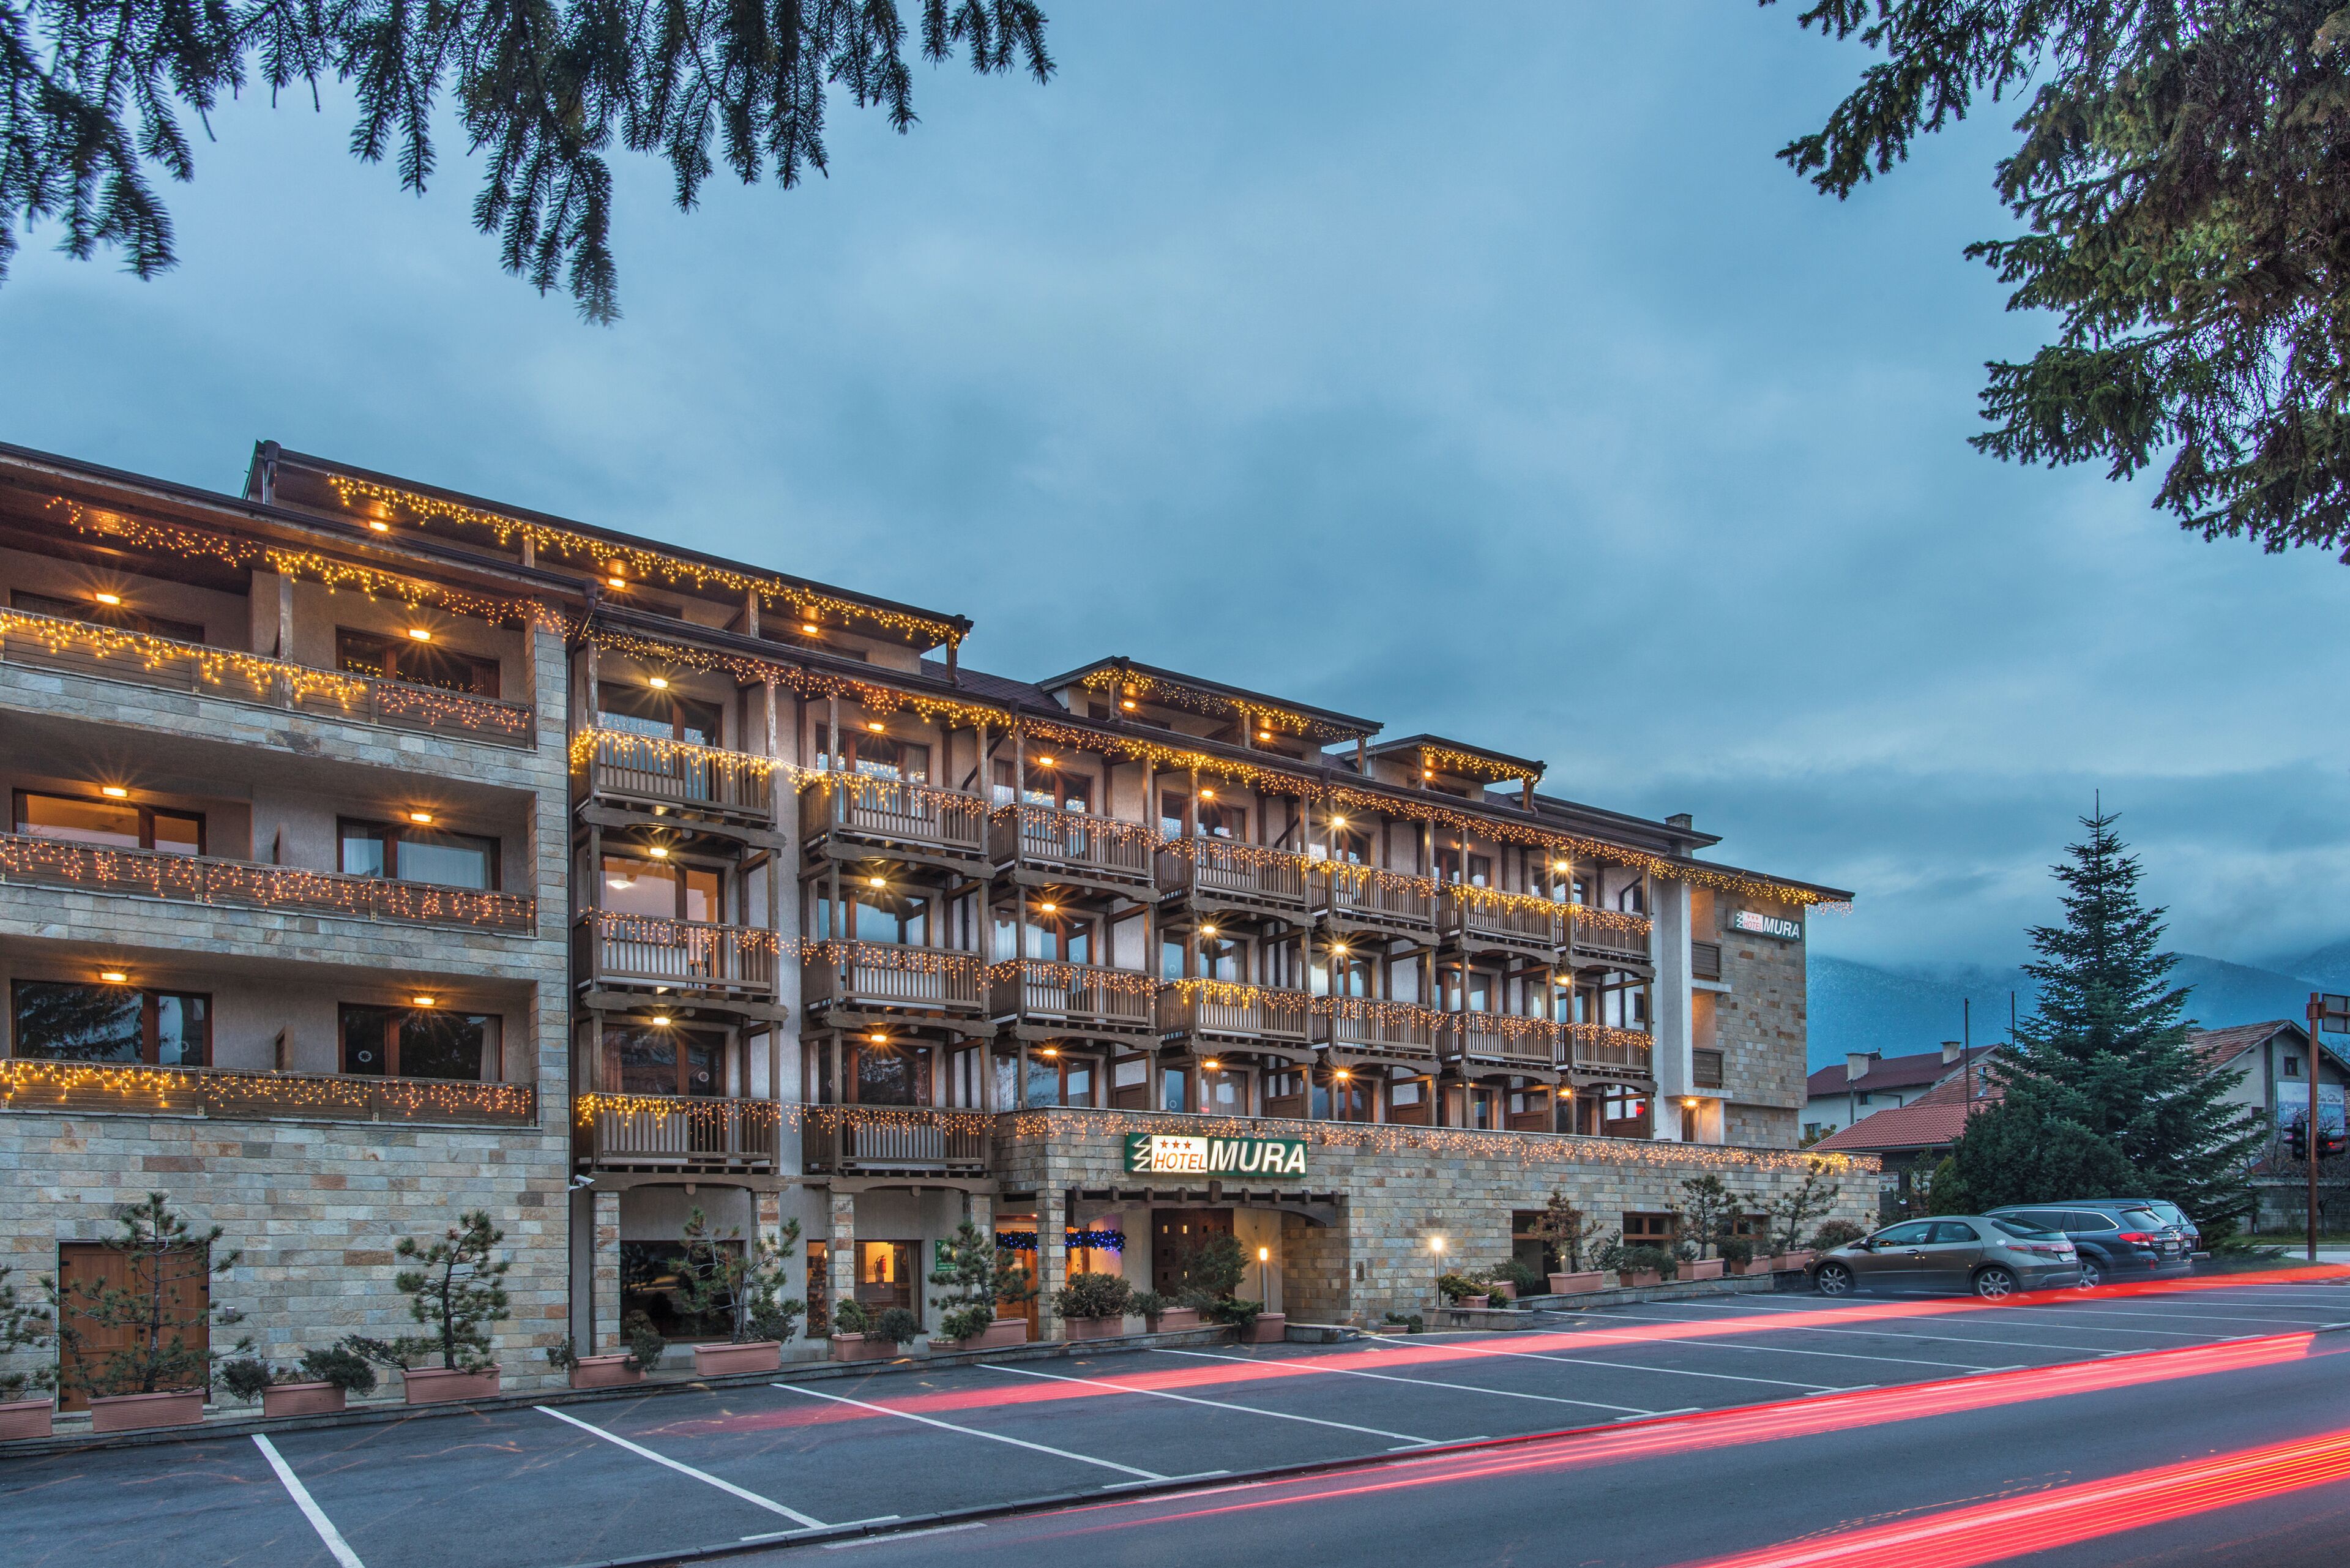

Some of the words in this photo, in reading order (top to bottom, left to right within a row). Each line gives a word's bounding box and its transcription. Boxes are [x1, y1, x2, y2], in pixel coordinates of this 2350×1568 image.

[1744, 920, 1762, 931] HOTEL
[1764, 917, 1800, 938] MURA
[1154, 1152, 1206, 1170] HOTEL
[1209, 1140, 1306, 1173] MURA
